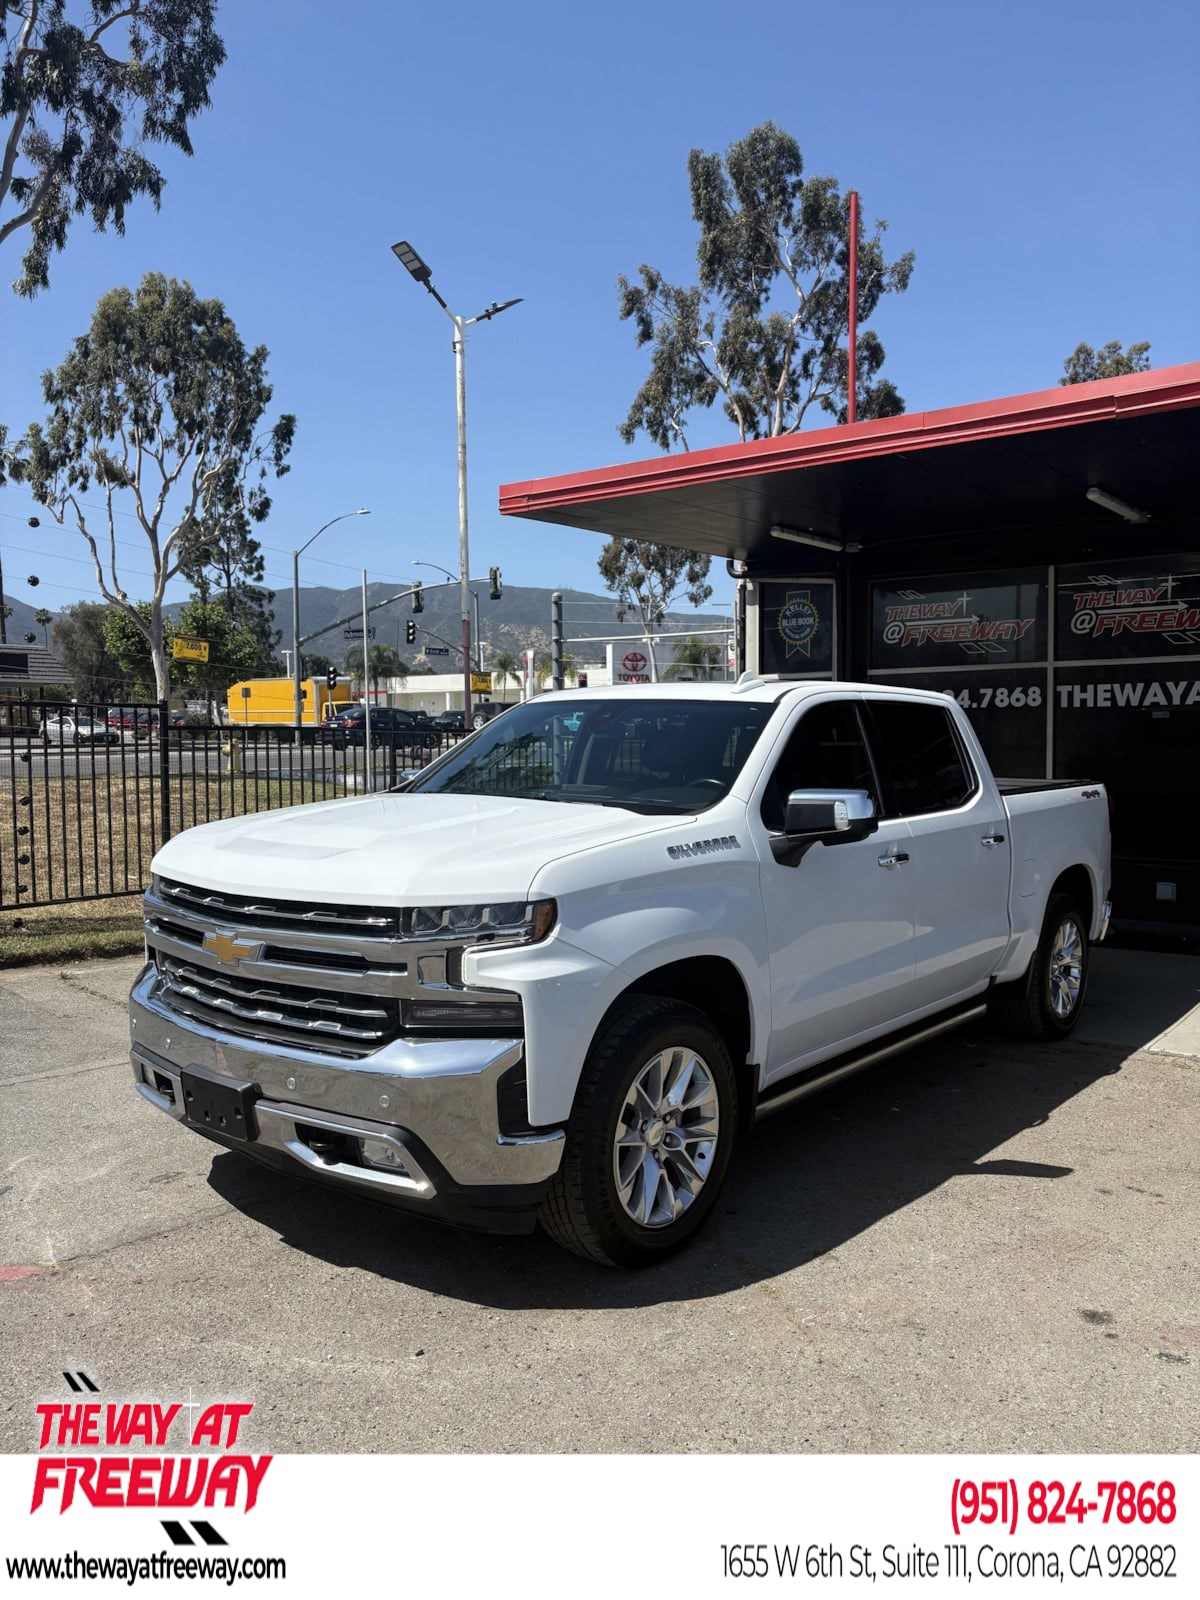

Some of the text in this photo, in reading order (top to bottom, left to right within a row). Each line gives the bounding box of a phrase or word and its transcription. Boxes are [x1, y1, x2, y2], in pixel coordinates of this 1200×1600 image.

[785, 603, 813, 616] KELLEY
[782, 617, 814, 627] BLUE BOOK
[883, 618, 1036, 648] @FREEWAY
[617, 673, 651, 683] TOYOTA
[666, 835, 738, 857] SILVERADO
